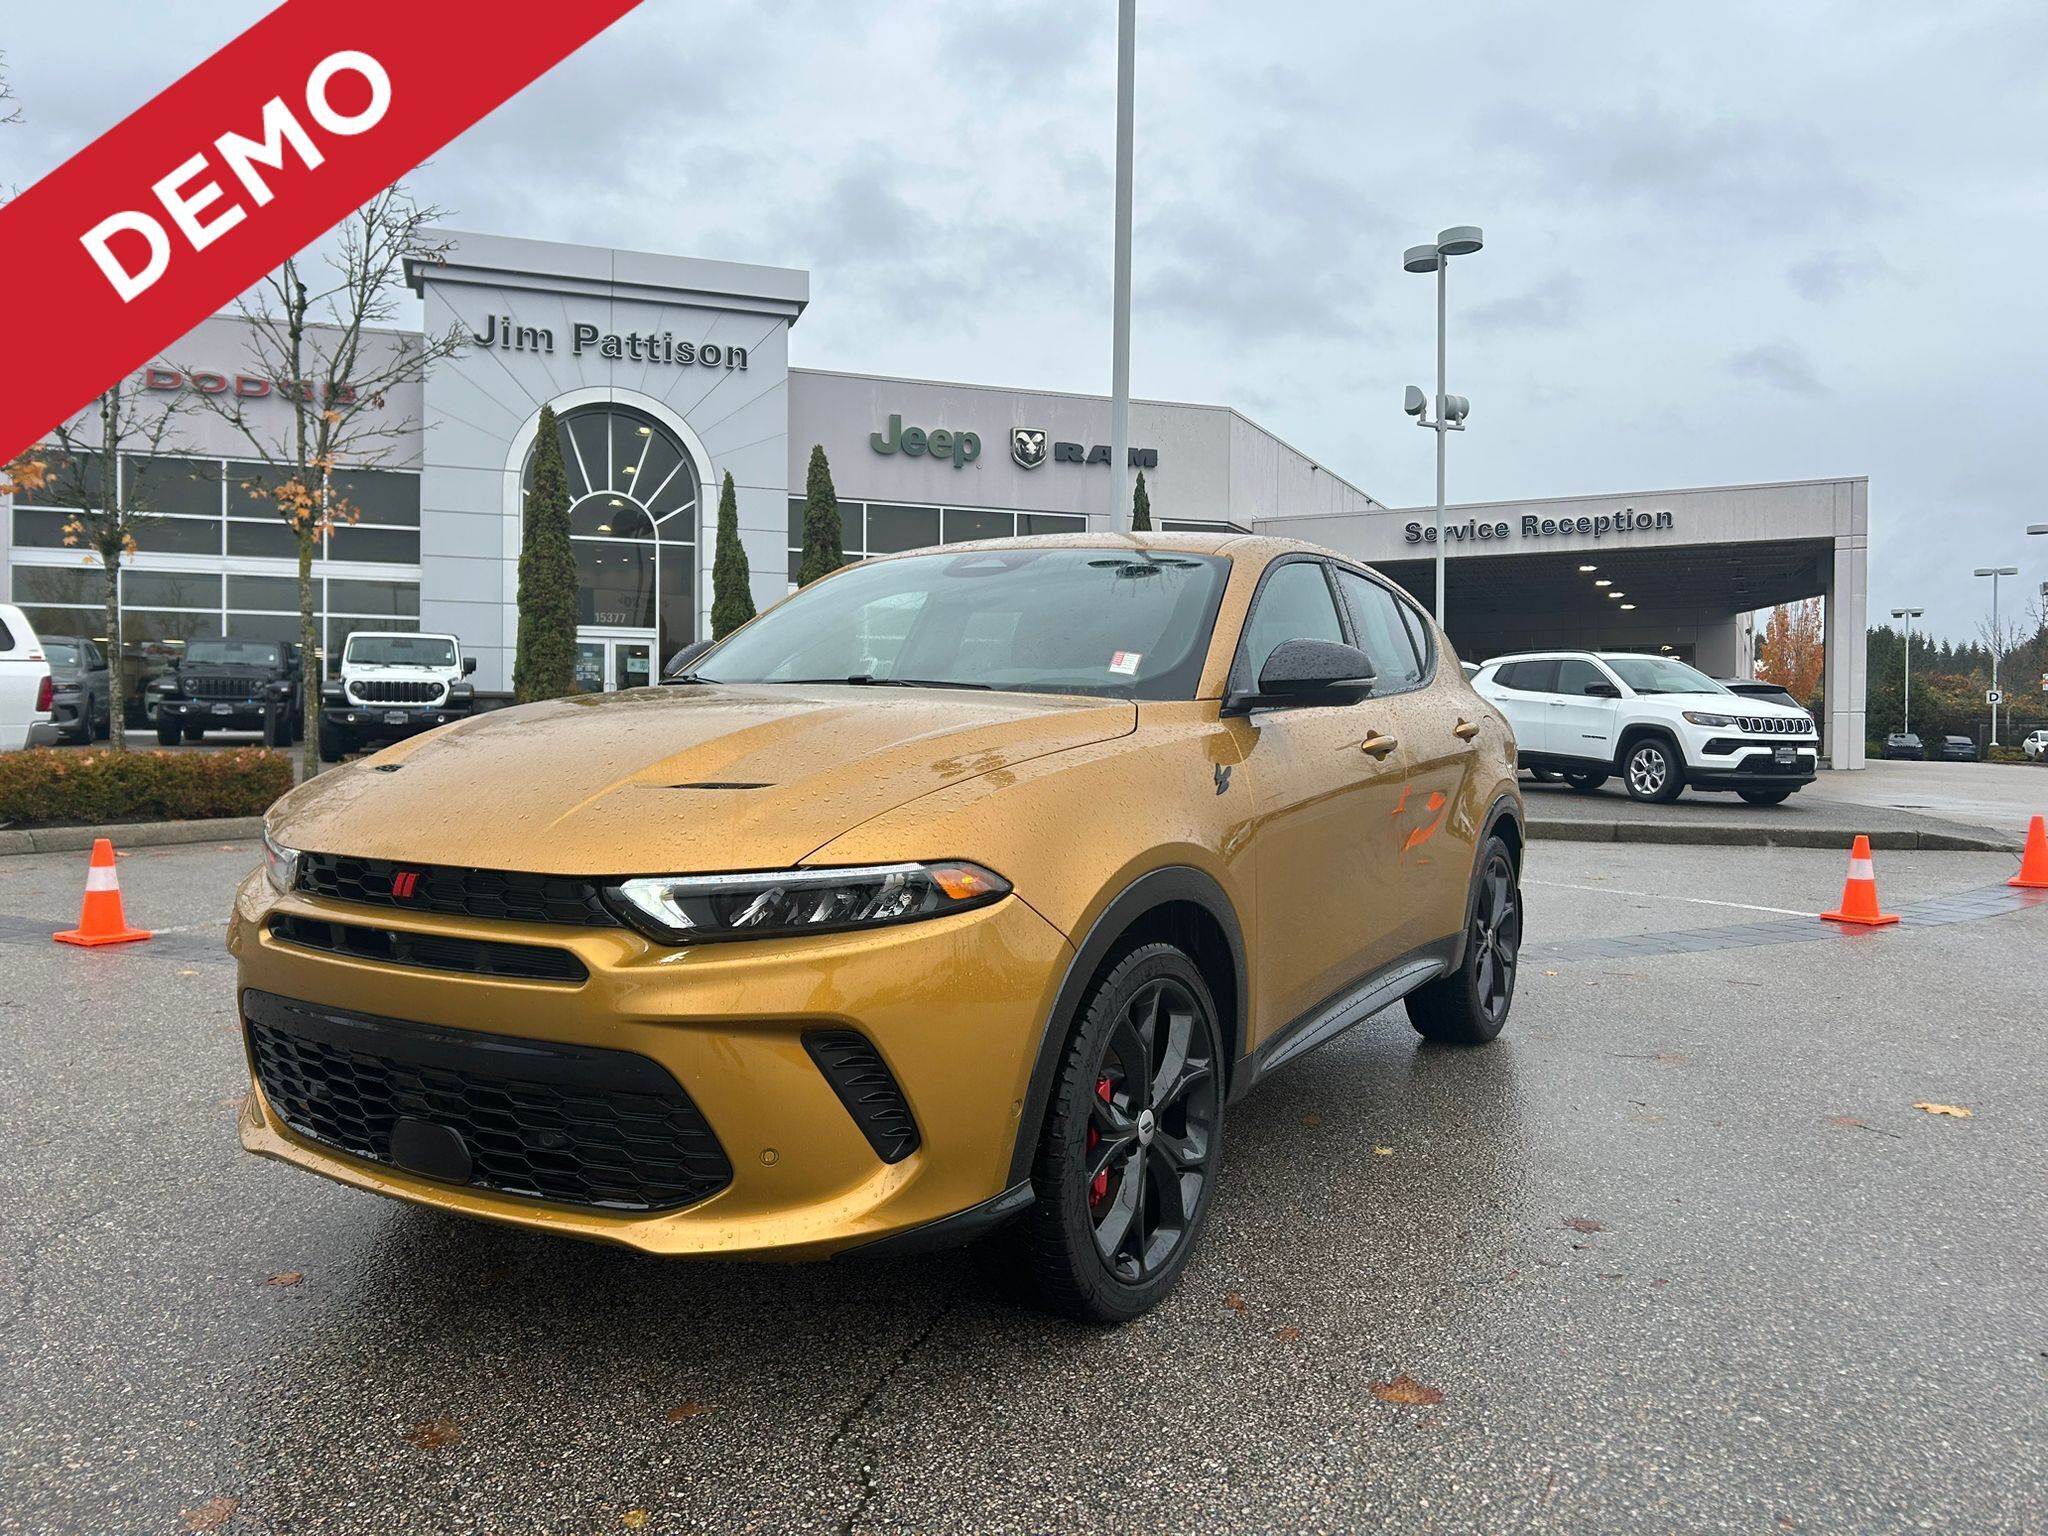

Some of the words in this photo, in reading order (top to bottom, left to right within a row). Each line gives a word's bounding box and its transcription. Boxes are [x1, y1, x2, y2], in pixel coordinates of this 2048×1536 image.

[473, 313, 554, 353] Jim
[572, 322, 749, 371] Pattison
[870, 414, 982, 468] Jeep
[1054, 441, 1158, 468] RAM
[1404, 518, 1511, 545] Service
[1520, 507, 1674, 538] Reception
[594, 612, 626, 624] 15377
[1990, 693, 1999, 701] D
